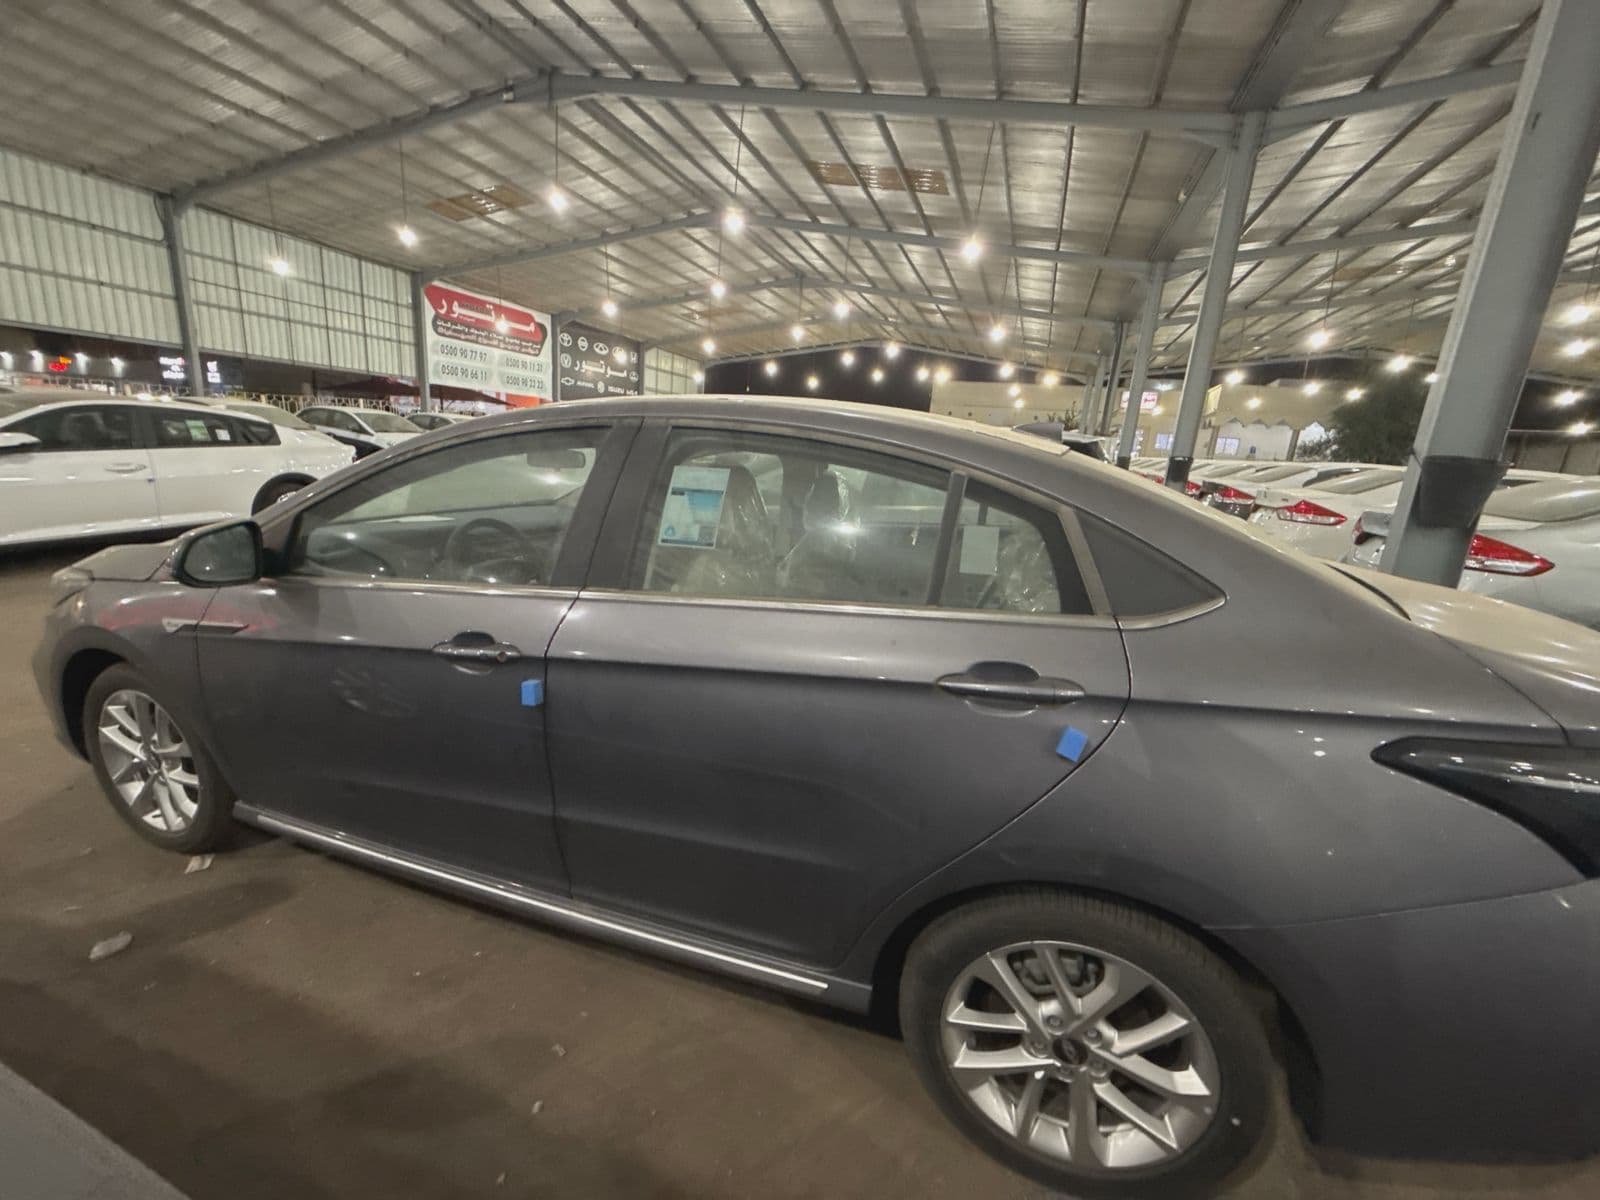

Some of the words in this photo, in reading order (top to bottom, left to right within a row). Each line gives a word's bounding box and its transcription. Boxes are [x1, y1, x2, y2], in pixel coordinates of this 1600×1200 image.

[440, 344, 458, 357] 0500
[459, 348, 468, 359] 90
[470, 350, 478, 361] 77
[441, 364, 459, 376] 0500
[460, 367, 469, 378] 90
[470, 369, 479, 380] 66
[480, 371, 487, 381] 11
